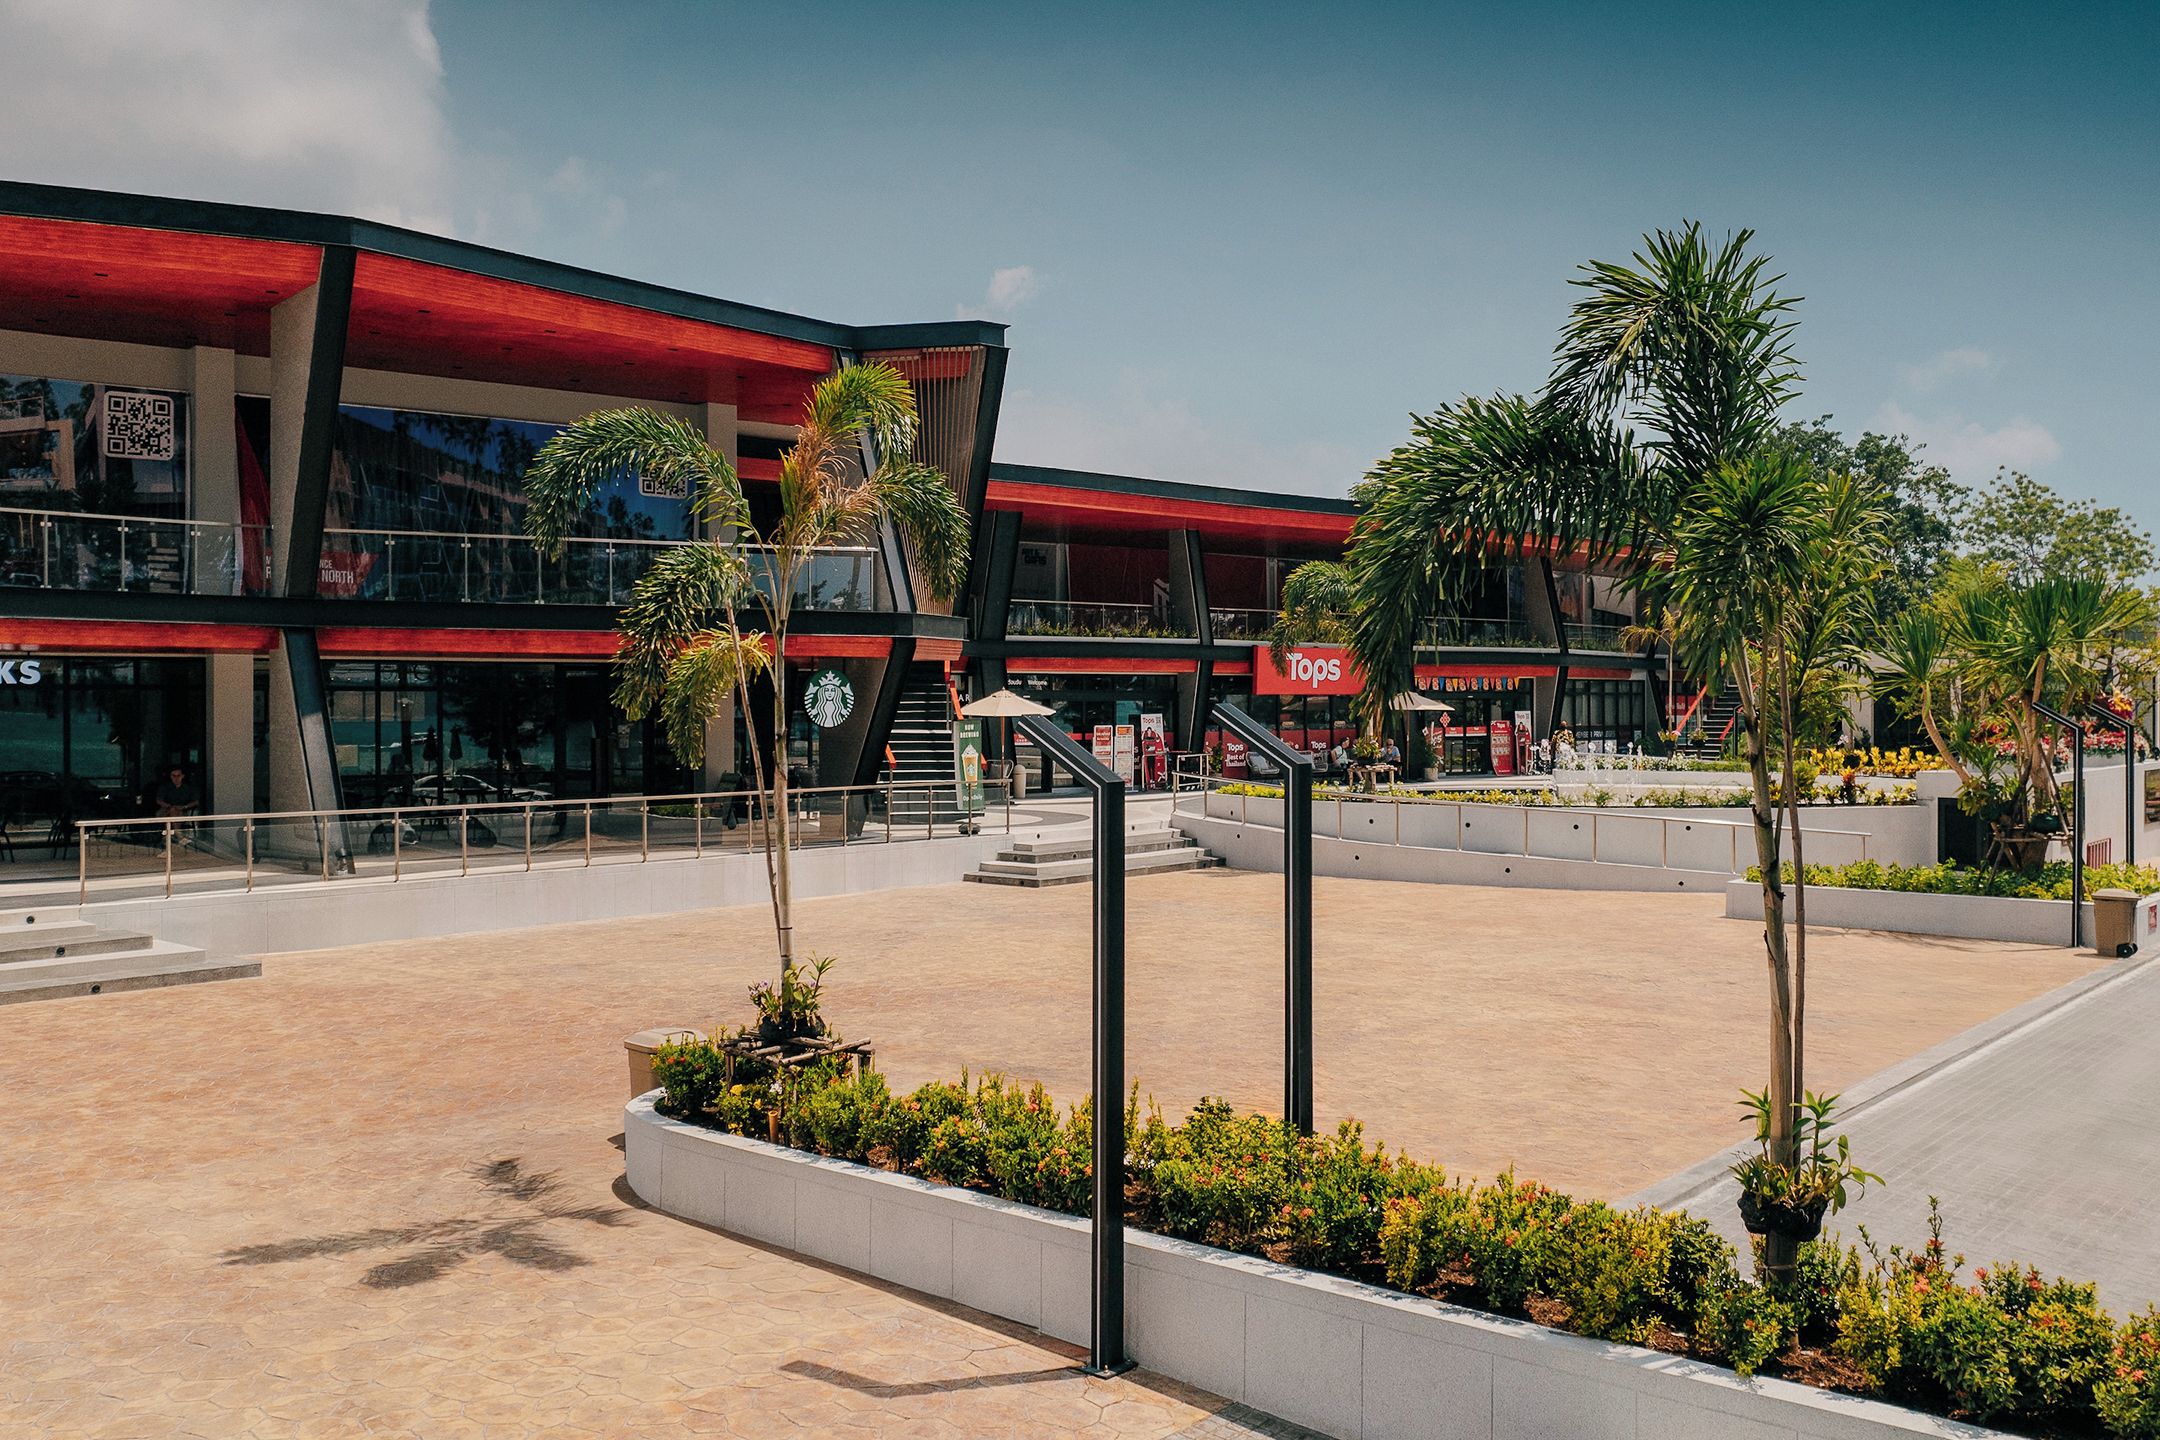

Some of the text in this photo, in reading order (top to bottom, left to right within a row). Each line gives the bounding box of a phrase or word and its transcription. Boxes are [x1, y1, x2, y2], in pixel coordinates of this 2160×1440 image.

[321, 570, 354, 584] NORTH
[0, 660, 41, 685] KS
[1286, 653, 1341, 689] Tops
[1227, 743, 1244, 752] Tops
[1311, 741, 1327, 750] Tops
